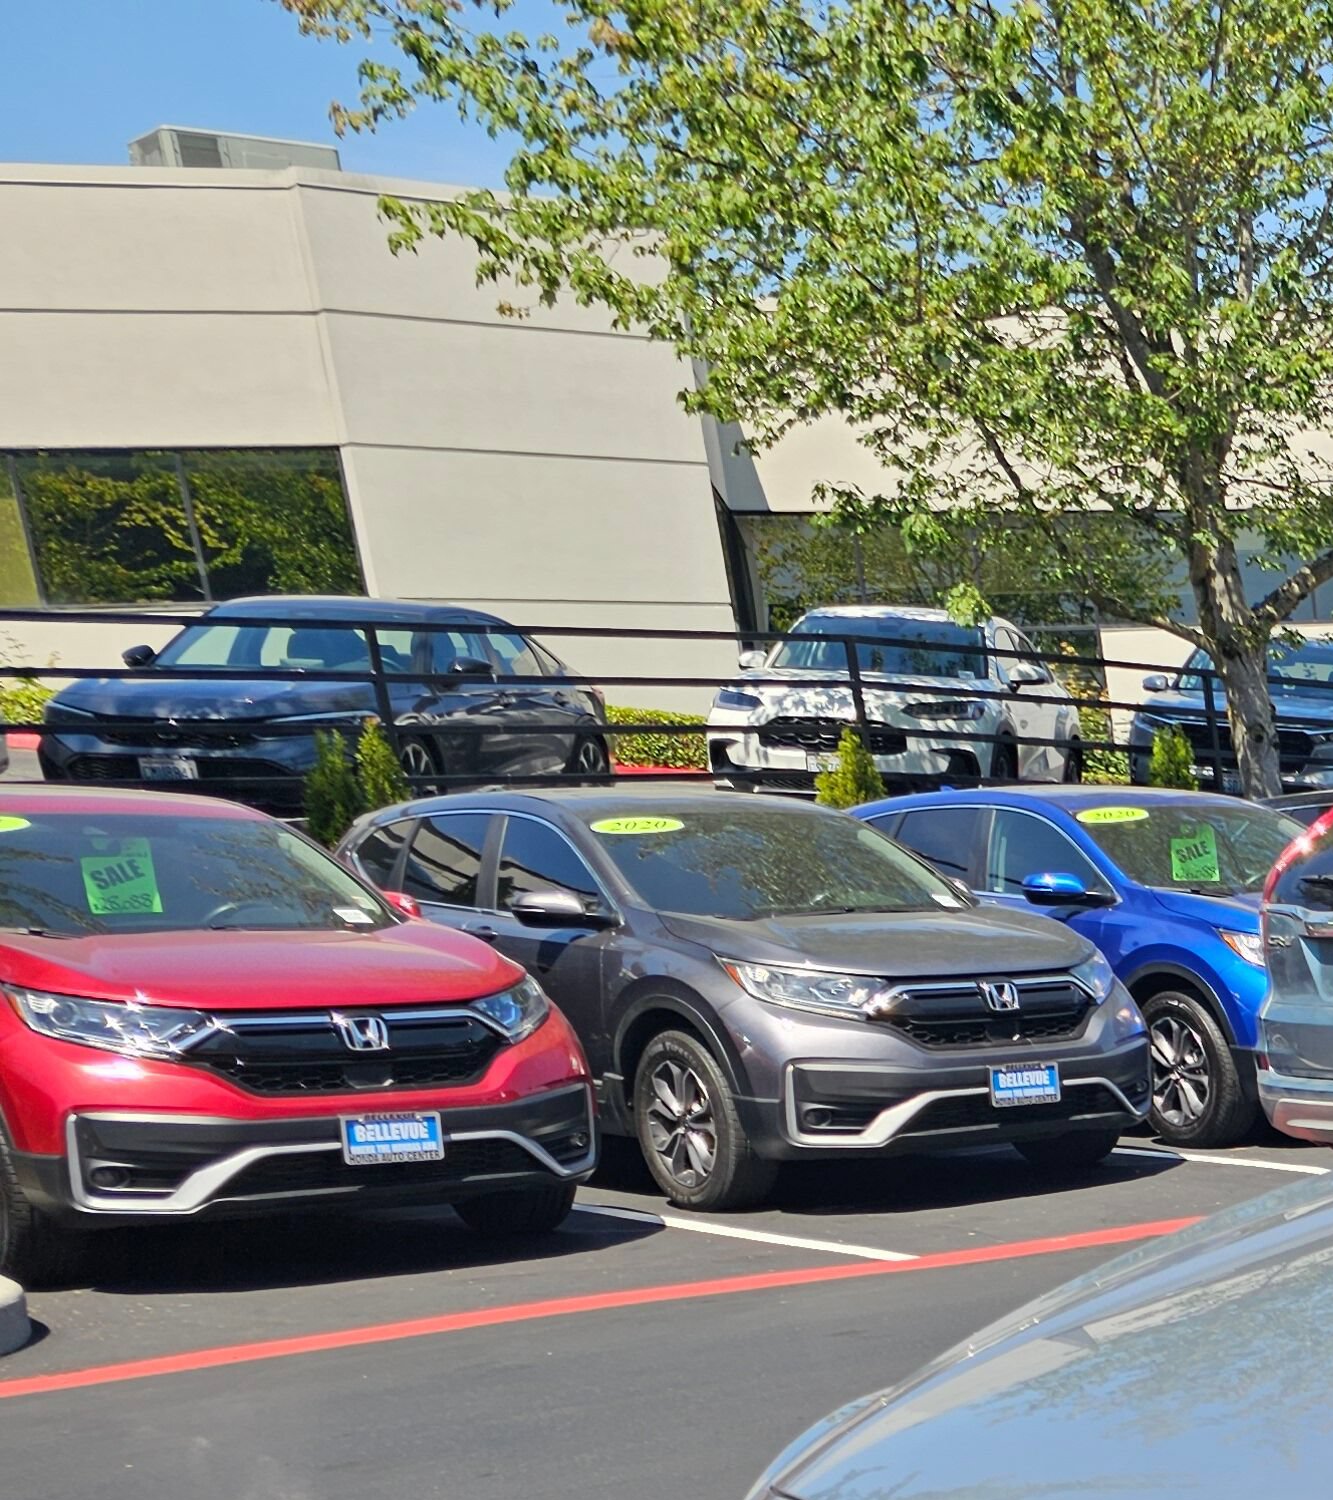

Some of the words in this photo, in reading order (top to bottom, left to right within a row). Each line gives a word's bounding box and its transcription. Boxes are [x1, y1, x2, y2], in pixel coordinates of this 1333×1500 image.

[1095, 810, 1136, 820] 2020
[608, 821, 667, 831] 2020
[1176, 840, 1211, 864] SALE
[90, 859, 146, 890] SALE
[998, 1069, 1049, 1089] BELLEVUE
[353, 1121, 430, 1143] BELLEVUE
[348, 1153, 379, 1163] HONDA
[381, 1152, 405, 1161] AUTO
[405, 1150, 440, 1160] CENTER
